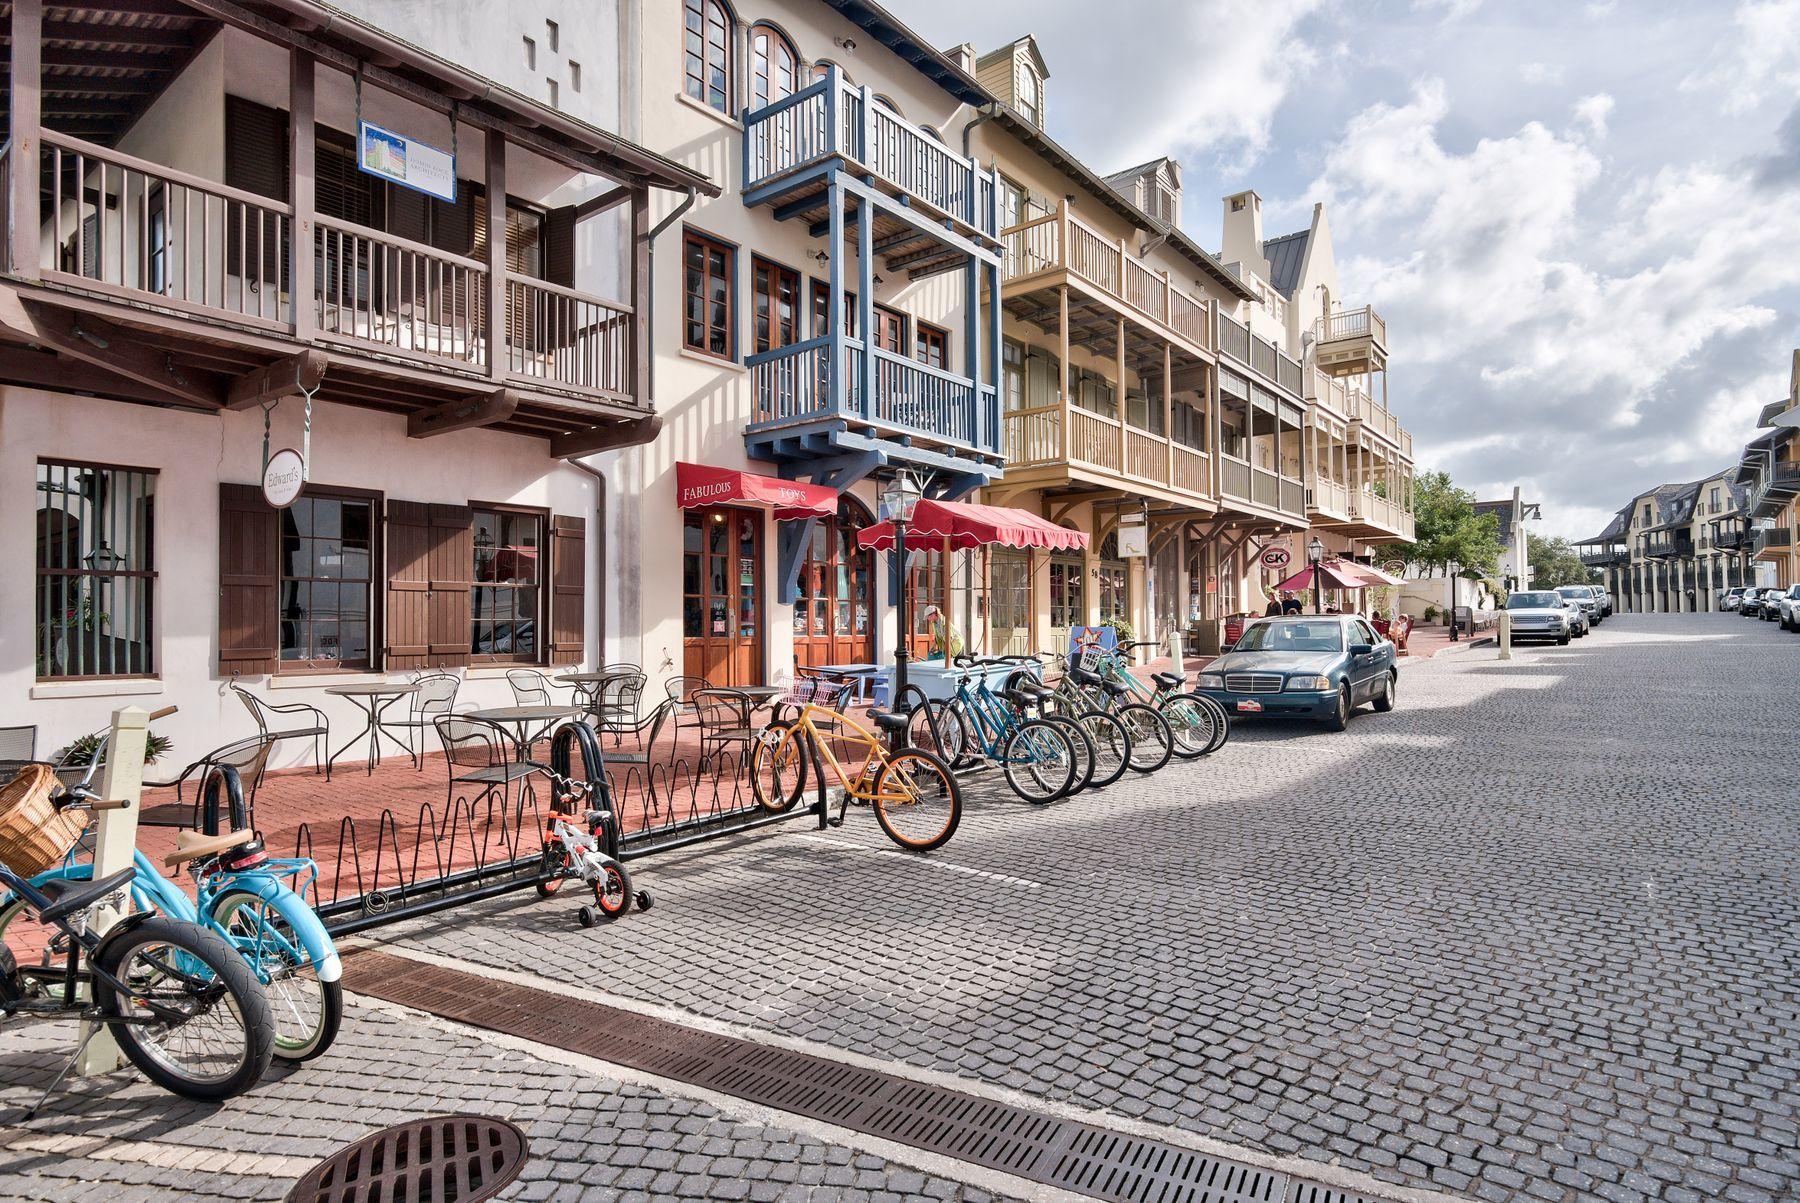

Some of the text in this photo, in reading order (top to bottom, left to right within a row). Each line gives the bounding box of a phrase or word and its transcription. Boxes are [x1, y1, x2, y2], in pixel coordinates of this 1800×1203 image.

[268, 466, 299, 488] Edward's
[683, 481, 807, 502] FABULOUS TOYS
